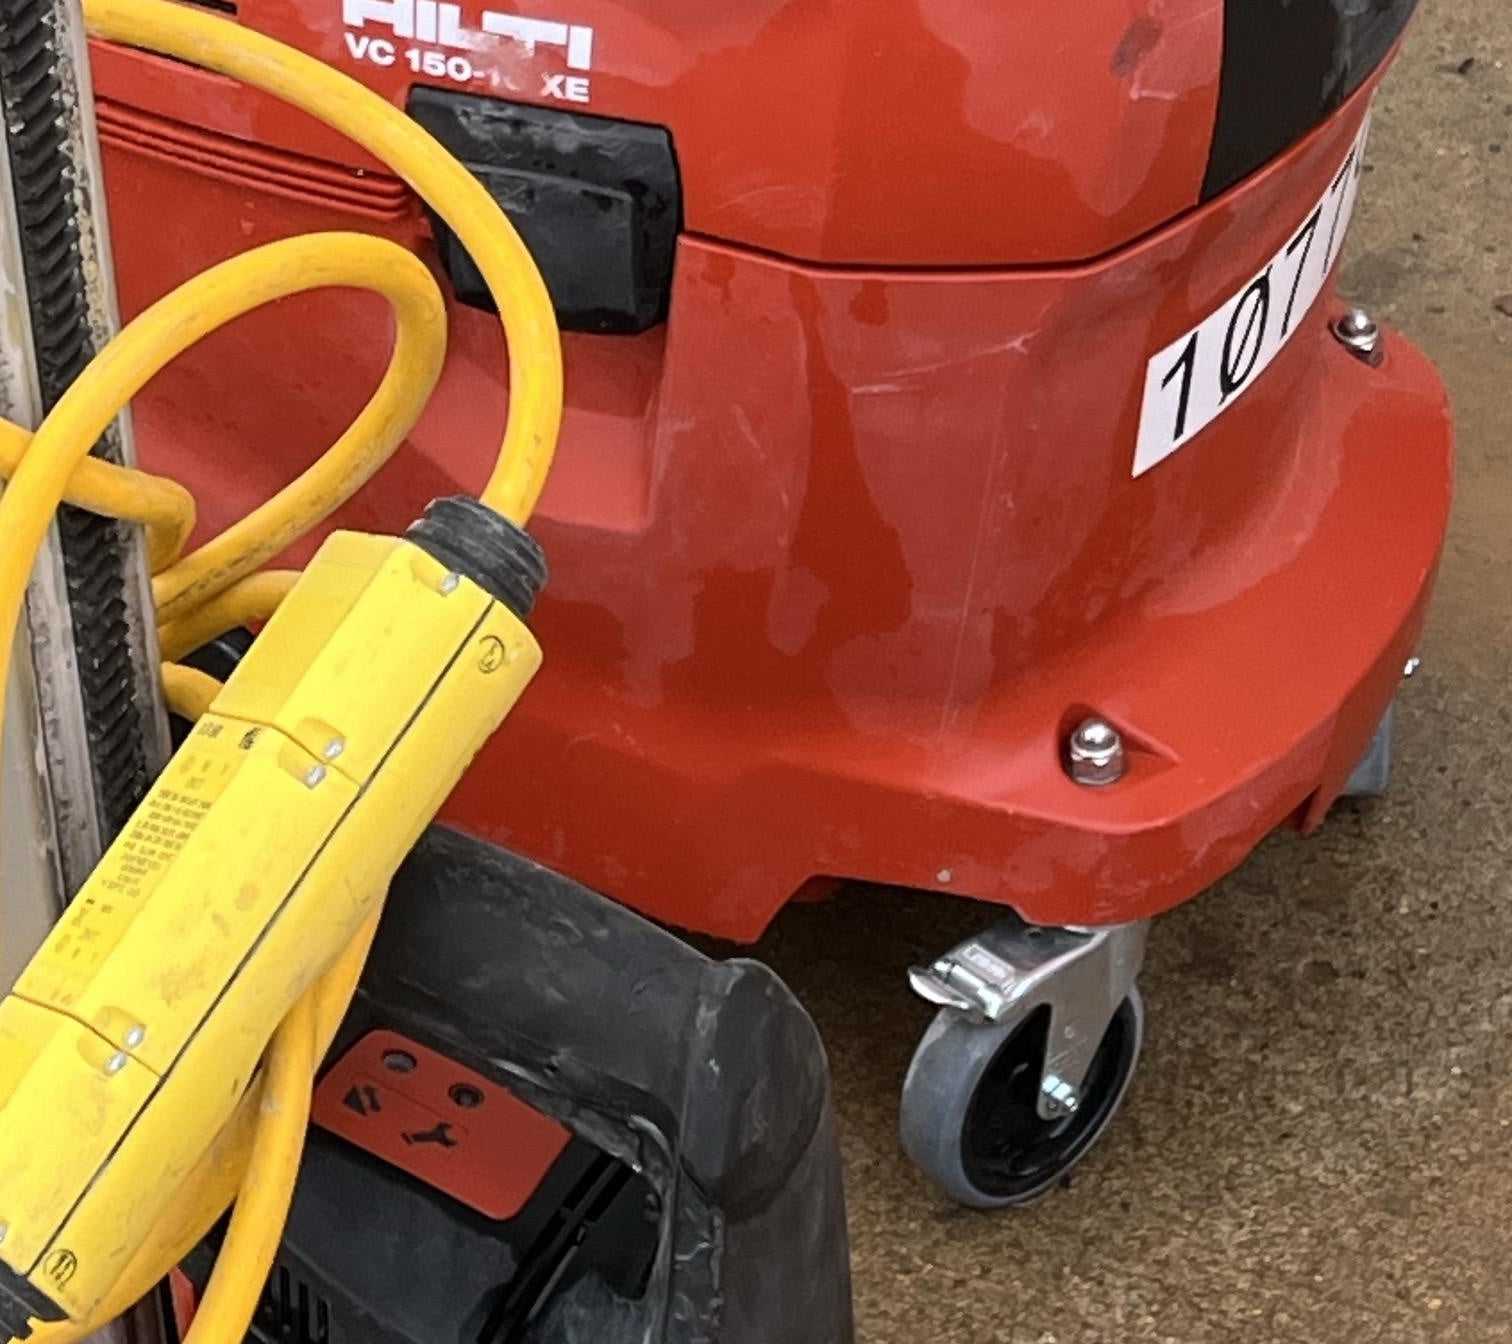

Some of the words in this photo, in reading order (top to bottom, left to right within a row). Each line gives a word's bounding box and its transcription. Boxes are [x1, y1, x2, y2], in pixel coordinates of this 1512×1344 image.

[344, 32, 395, 65] VC
[405, 47, 521, 91] 150-1
[541, 71, 589, 102] XE
[1161, 145, 1360, 443] 1077
